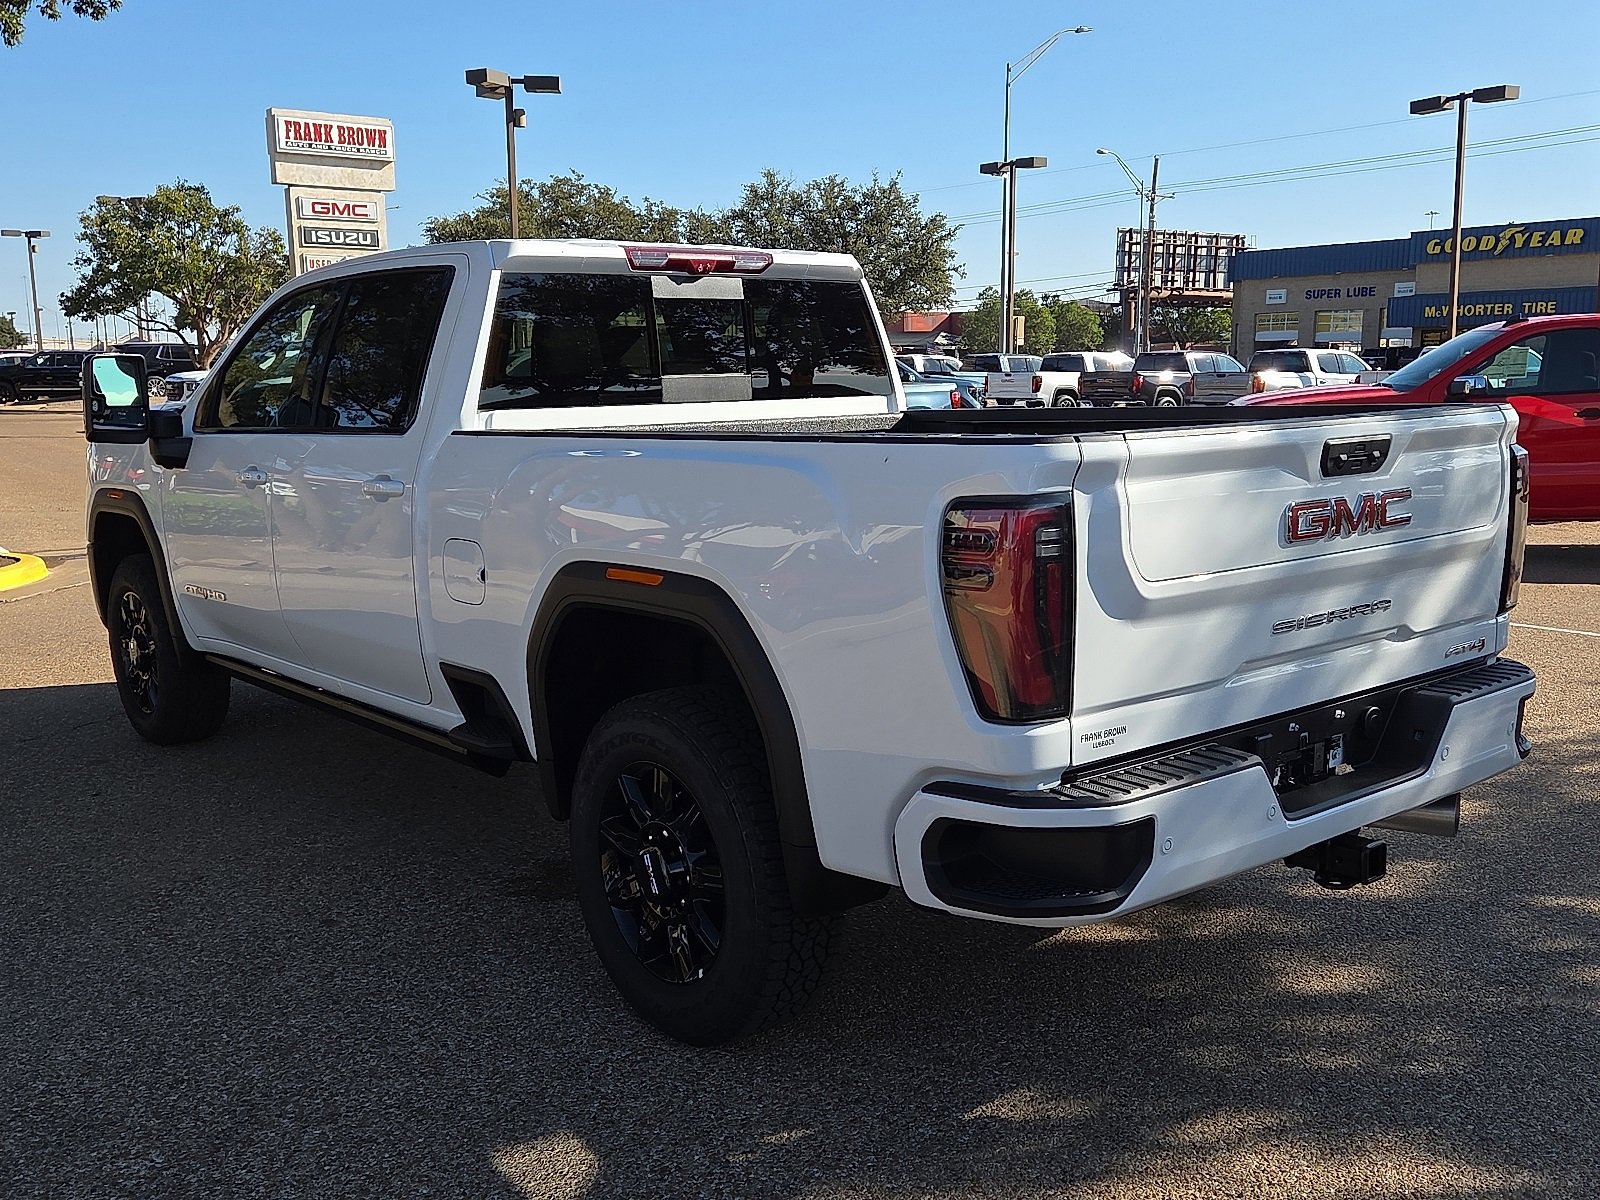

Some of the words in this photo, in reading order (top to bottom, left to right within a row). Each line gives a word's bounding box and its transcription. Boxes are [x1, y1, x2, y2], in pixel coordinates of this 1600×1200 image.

[284, 120, 334, 143] FRANK
[337, 125, 387, 148] BROWN
[286, 141, 309, 149] AUTO
[331, 145, 358, 153] TRUCK
[311, 202, 369, 217] GMC
[311, 230, 372, 245] ISUZU
[1305, 288, 1341, 300] SUPER
[1346, 286, 1377, 298] LUBE
[1522, 301, 1557, 314] TIRE
[1285, 487, 1413, 546] GMC
[1271, 599, 1392, 636] SIERRA
[1445, 636, 1486, 659] AT4
[1080, 731, 1103, 743] FRANK
[1103, 725, 1127, 740] BROWN
